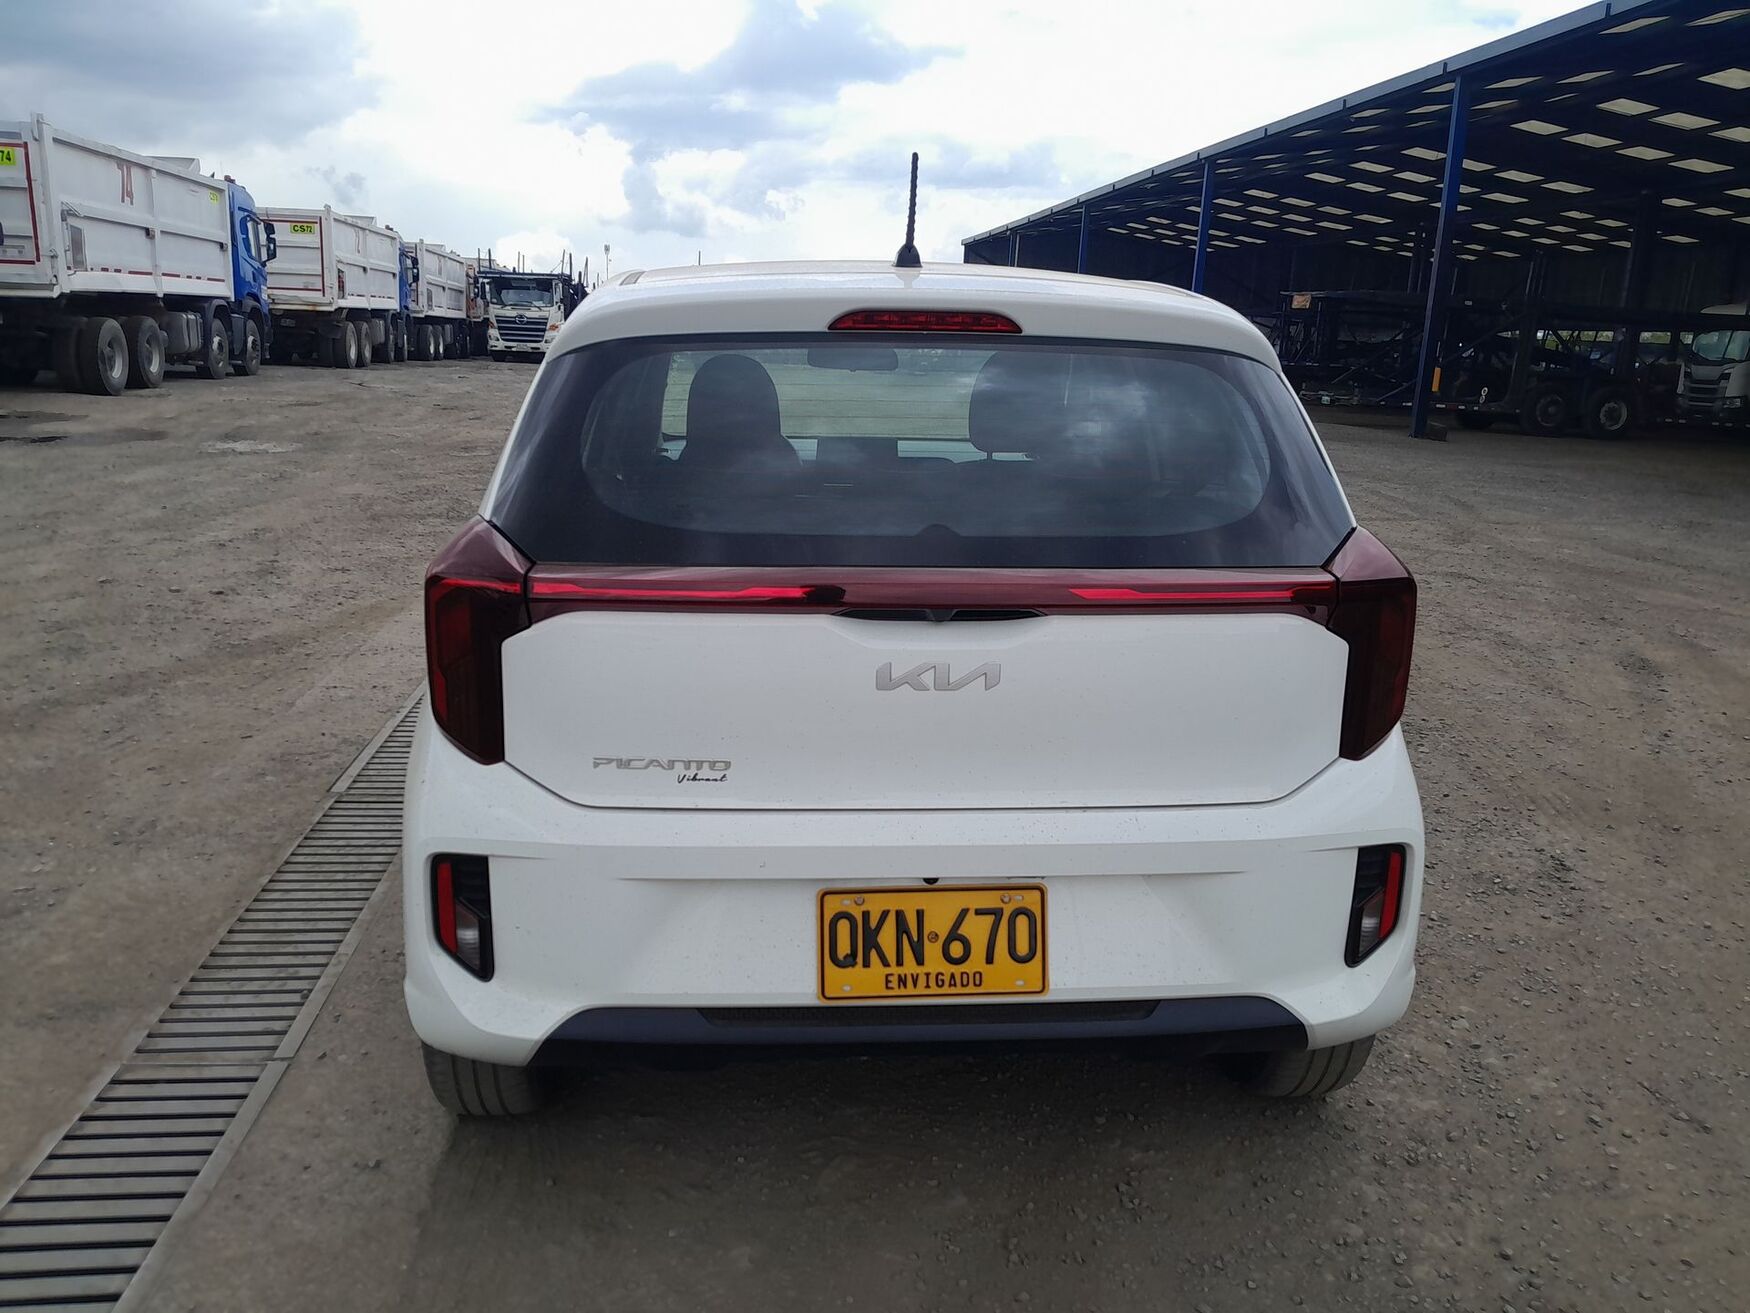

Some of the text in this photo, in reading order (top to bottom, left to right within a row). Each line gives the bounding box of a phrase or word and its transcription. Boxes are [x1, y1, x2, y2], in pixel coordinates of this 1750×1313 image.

[876, 662, 1001, 691] KIA
[592, 757, 732, 772] PICANTO
[677, 773, 728, 784] Vibrant
[828, 907, 1038, 969] QKN 670
[884, 971, 983, 990] ENVIGADO
